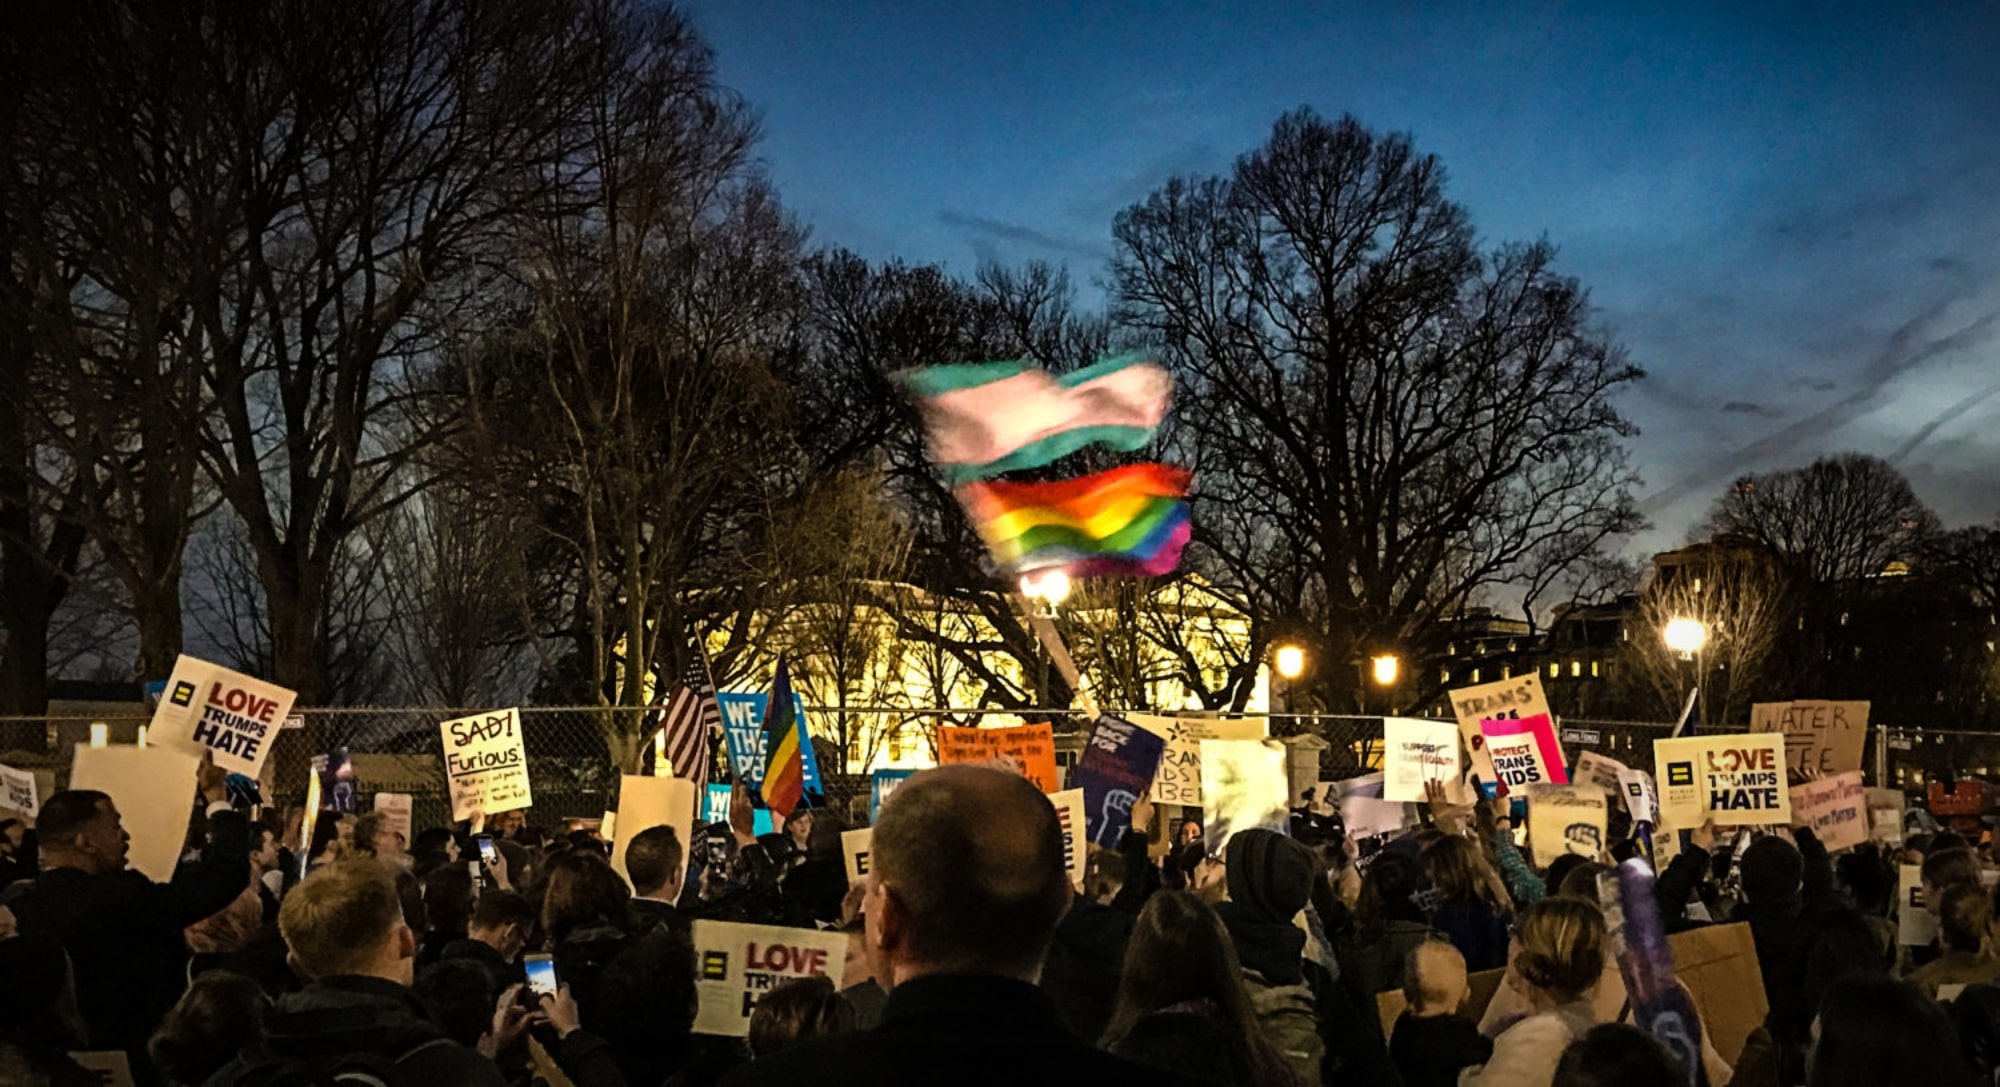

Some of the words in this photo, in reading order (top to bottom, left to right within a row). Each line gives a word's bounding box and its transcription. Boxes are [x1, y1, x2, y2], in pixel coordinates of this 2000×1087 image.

[208, 682, 279, 723] LOVE
[723, 701, 760, 728] WE
[204, 705, 267, 738] TRUMPS
[450, 711, 512, 747] SAD!
[1757, 704, 1850, 733] WATER
[192, 721, 260, 761] HATE
[729, 728, 769, 755] THE
[1160, 749, 1200, 768] RAN
[1706, 748, 1776, 772] LOVE
[1499, 766, 1541, 786] IDS
[1709, 788, 1780, 810] HATE
[746, 942, 828, 975] LOVE
[744, 972, 793, 990] TRU
